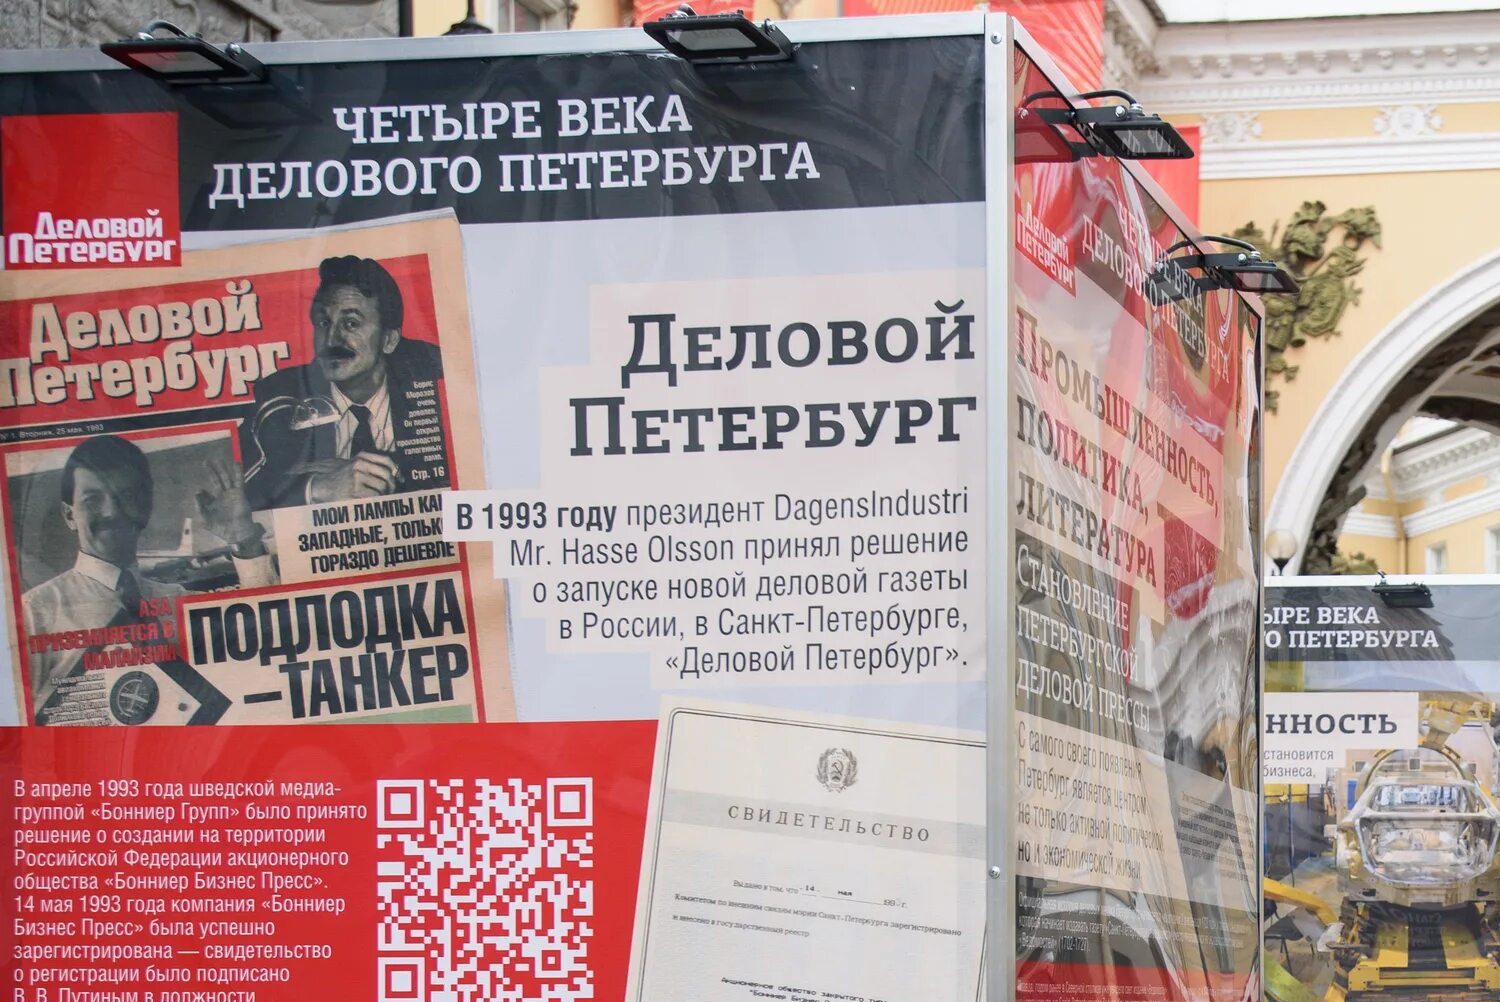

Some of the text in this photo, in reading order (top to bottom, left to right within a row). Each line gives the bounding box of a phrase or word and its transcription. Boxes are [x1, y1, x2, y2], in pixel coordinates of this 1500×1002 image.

[333, 95, 692, 143] ЧЕТЫРЕ ВЕКА
[210, 142, 820, 208] ДЕЛОВОГО ПЕТЕРБУРГА
[34, 209, 163, 240] Деловой
[1026, 202, 1069, 264] Деловой
[9, 233, 177, 263] Петербург
[1082, 214, 1230, 383] ДЕЛОВОГО ПЕТЕРБУРГА
[1173, 258, 1204, 317] ВЕКА
[30, 280, 261, 364] Деловой
[0, 340, 290, 407] Петербург
[411, 466, 445, 480] Стр. 16
[312, 505, 350, 526] МОИ
[353, 499, 414, 522] ЛАМПЫ
[457, 486, 967, 532] В 1993 году президент DagensIndustri
[298, 528, 388, 552] ЗАПАДНЫЕ,
[310, 542, 455, 574] ГОРАЗДО ДЕШЕВЛЕ
[511, 531, 968, 566] Mr. Hasse Olsson принял решение
[534, 568, 967, 607] о запуске новой деловой газеты
[188, 578, 465, 666] ПОДЛОДКА
[560, 603, 966, 640] в России, в Санкт-Петербурге,
[1317, 606, 1380, 624] ВЕКА
[30, 624, 158, 654] ПРИЗЕМЛЯЕТСЯ
[84, 643, 177, 671] МАЛАЙЗИИ
[1017, 605, 1138, 682] ПЕТЕРБУРГСКОЙ
[1288, 630, 1439, 648] ПЕТЕРБУРГА
[666, 641, 966, 679] «Деловой Петербург».
[1016, 658, 1150, 732] ДЕЛОВОЙ ПРЕССЫ
[1018, 721, 1142, 780] С самого своего появления
[1264, 751, 1334, 760] становится
[16, 780, 341, 800] В апреле 1993 года шведской медиа-
[1263, 765, 1316, 778] бизнеса,
[727, 805, 931, 842] СВИДЕТЕЛЬСТВО
